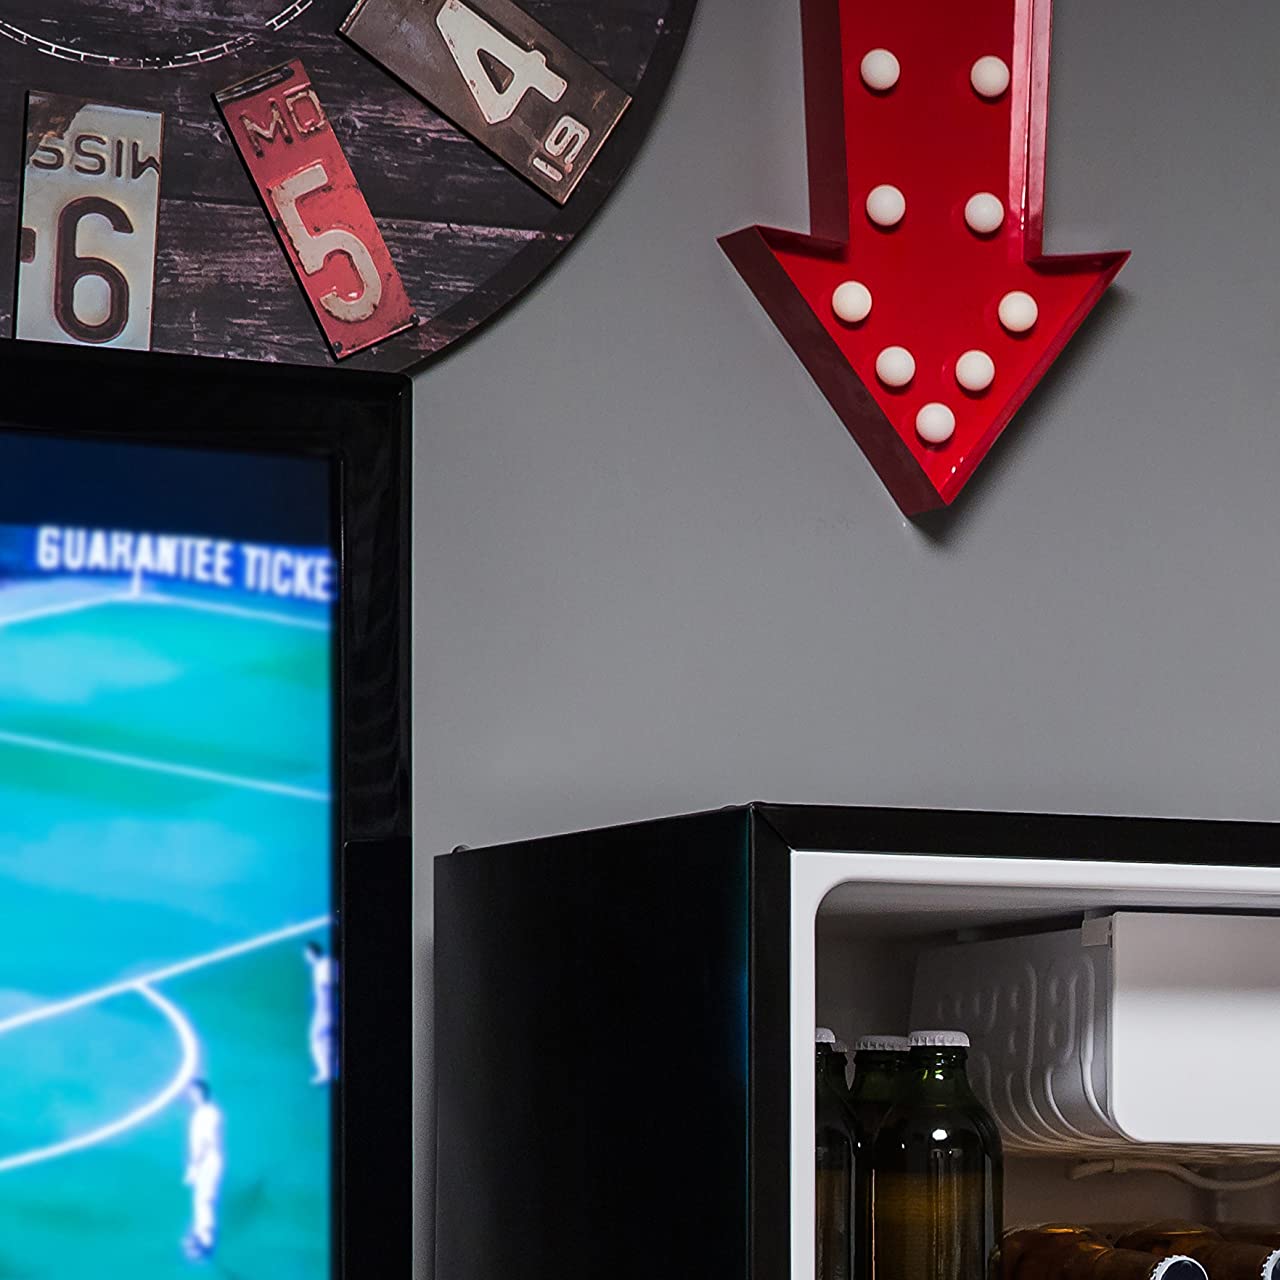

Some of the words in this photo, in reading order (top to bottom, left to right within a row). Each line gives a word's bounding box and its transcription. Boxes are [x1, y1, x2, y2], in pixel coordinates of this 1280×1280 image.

[437, 0, 567, 125] 4
[53, 196, 134, 344] 6
[269, 162, 382, 323] 5
[36, 525, 234, 588] GUARANTEE
